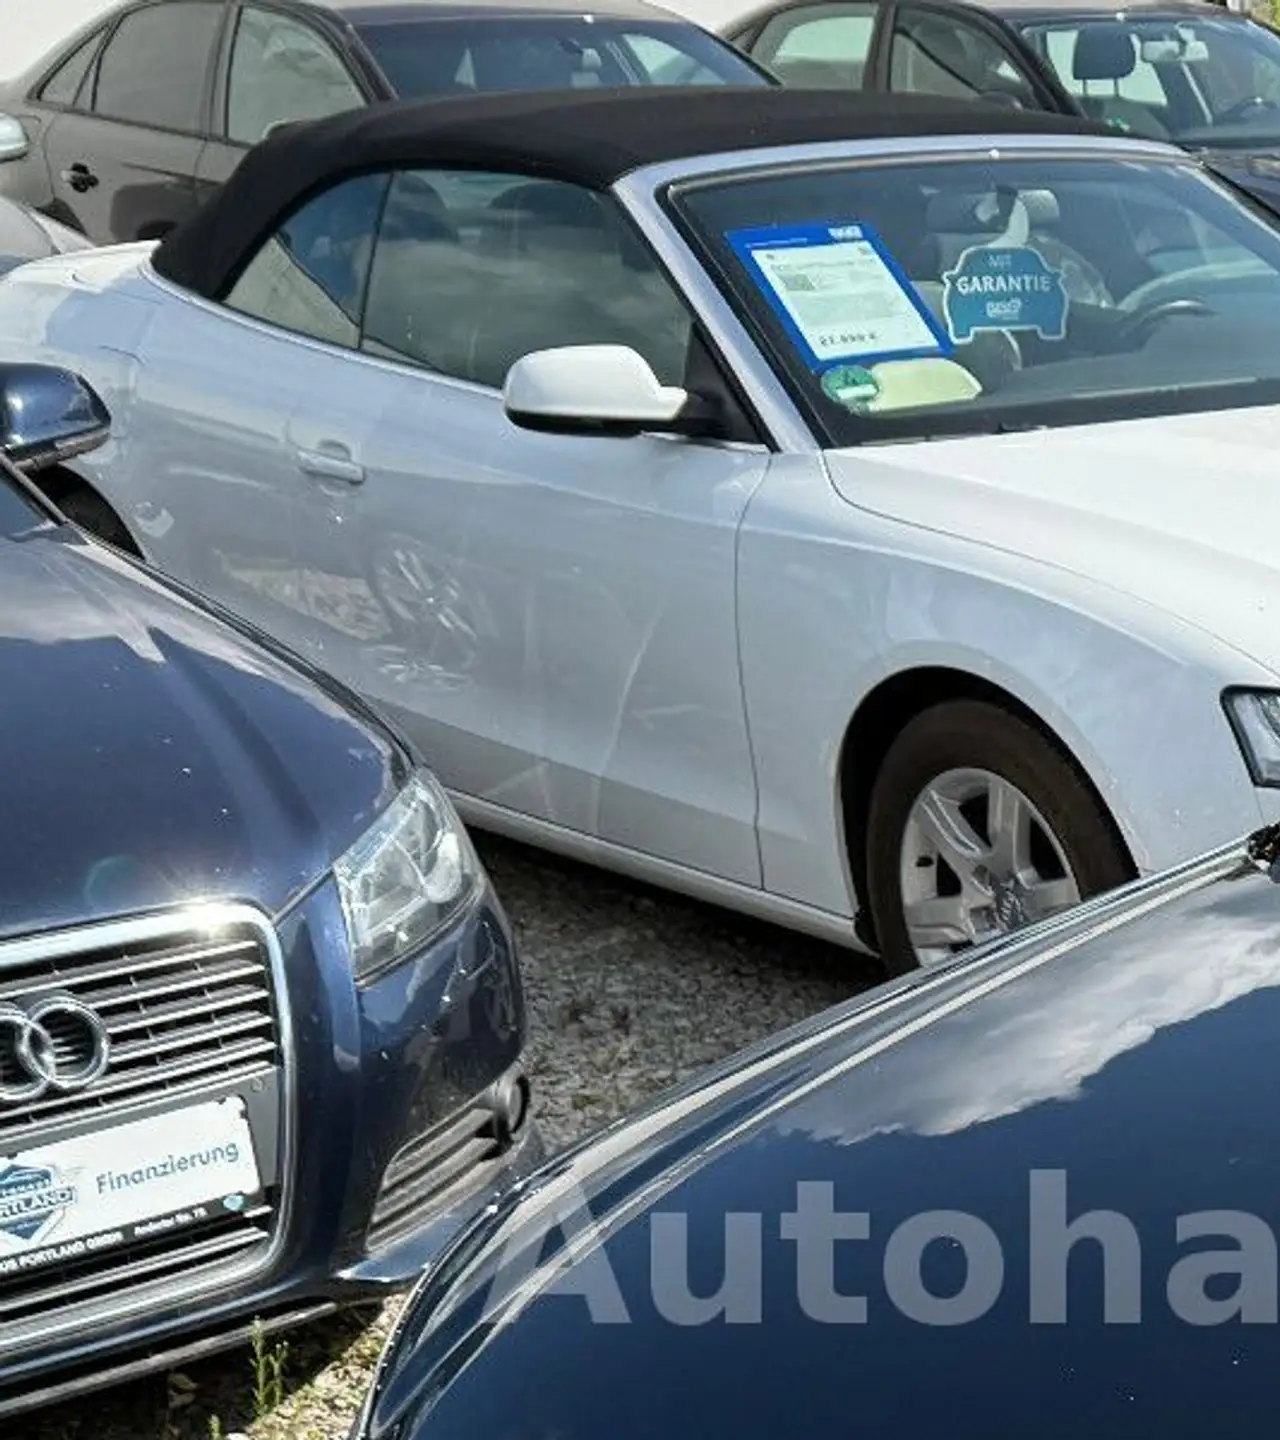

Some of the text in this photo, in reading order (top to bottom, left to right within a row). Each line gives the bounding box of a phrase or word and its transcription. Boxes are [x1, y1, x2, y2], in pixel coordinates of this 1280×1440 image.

[957, 273, 1052, 295] GARANTIE
[96, 1142, 239, 1194] Finanzierung
[19, 1240, 85, 1268] PORTLAND
